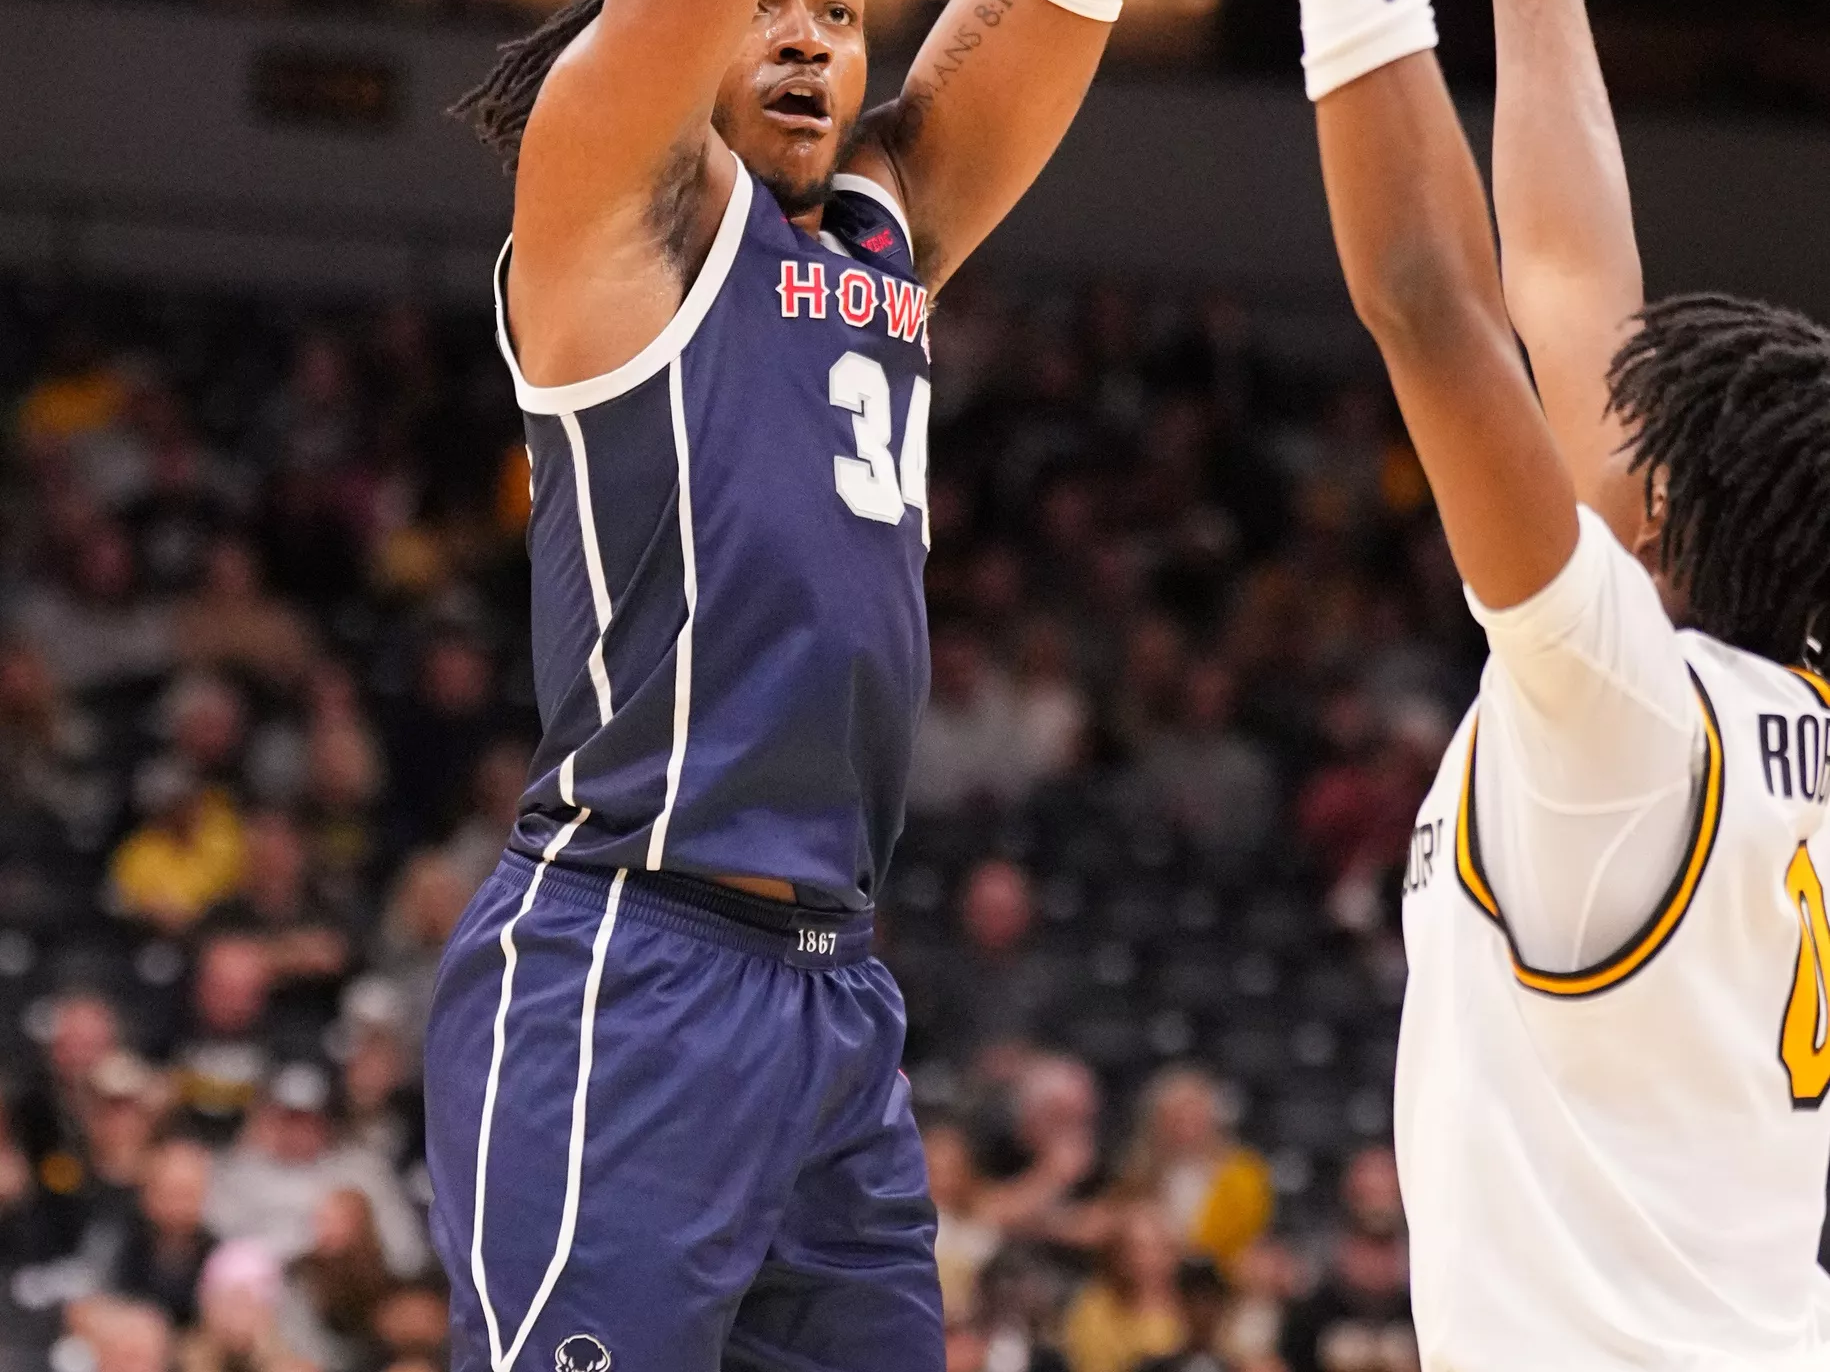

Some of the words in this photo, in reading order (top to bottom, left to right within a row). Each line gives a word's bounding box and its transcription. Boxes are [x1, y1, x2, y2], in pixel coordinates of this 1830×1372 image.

[776, 260, 931, 365] HOW
[1757, 712, 1830, 805] RO
[796, 929, 838, 955] 1867
